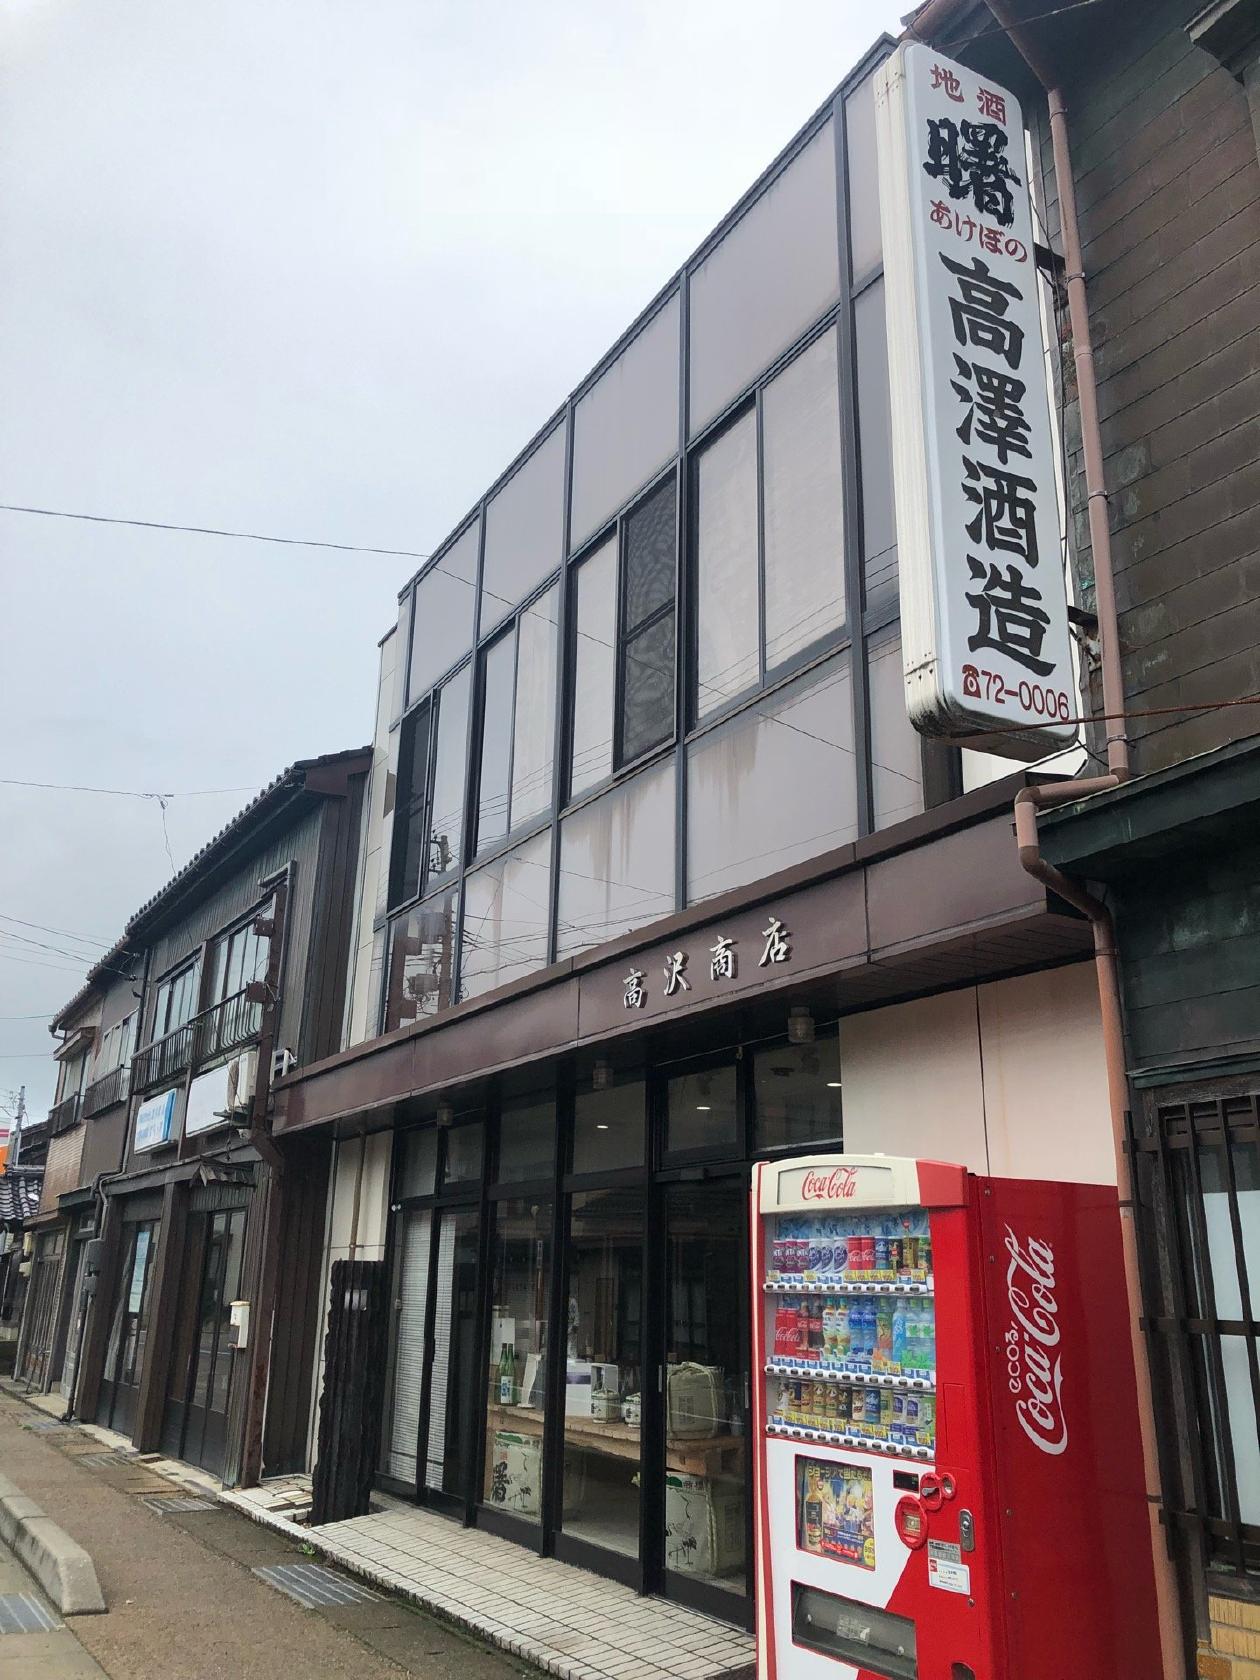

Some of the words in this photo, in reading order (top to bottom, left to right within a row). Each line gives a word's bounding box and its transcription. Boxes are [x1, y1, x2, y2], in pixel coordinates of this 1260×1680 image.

[930, 64, 1006, 126] 地酒
[923, 117, 1022, 229] 曙
[930, 200, 1028, 263] あけぼの
[939, 251, 1057, 677] 高澤酒造
[622, 916, 792, 1009] 高沢商店
[802, 1167, 857, 1200] Coca-Cola
[1004, 1222, 1068, 1455] Coca-Cola
